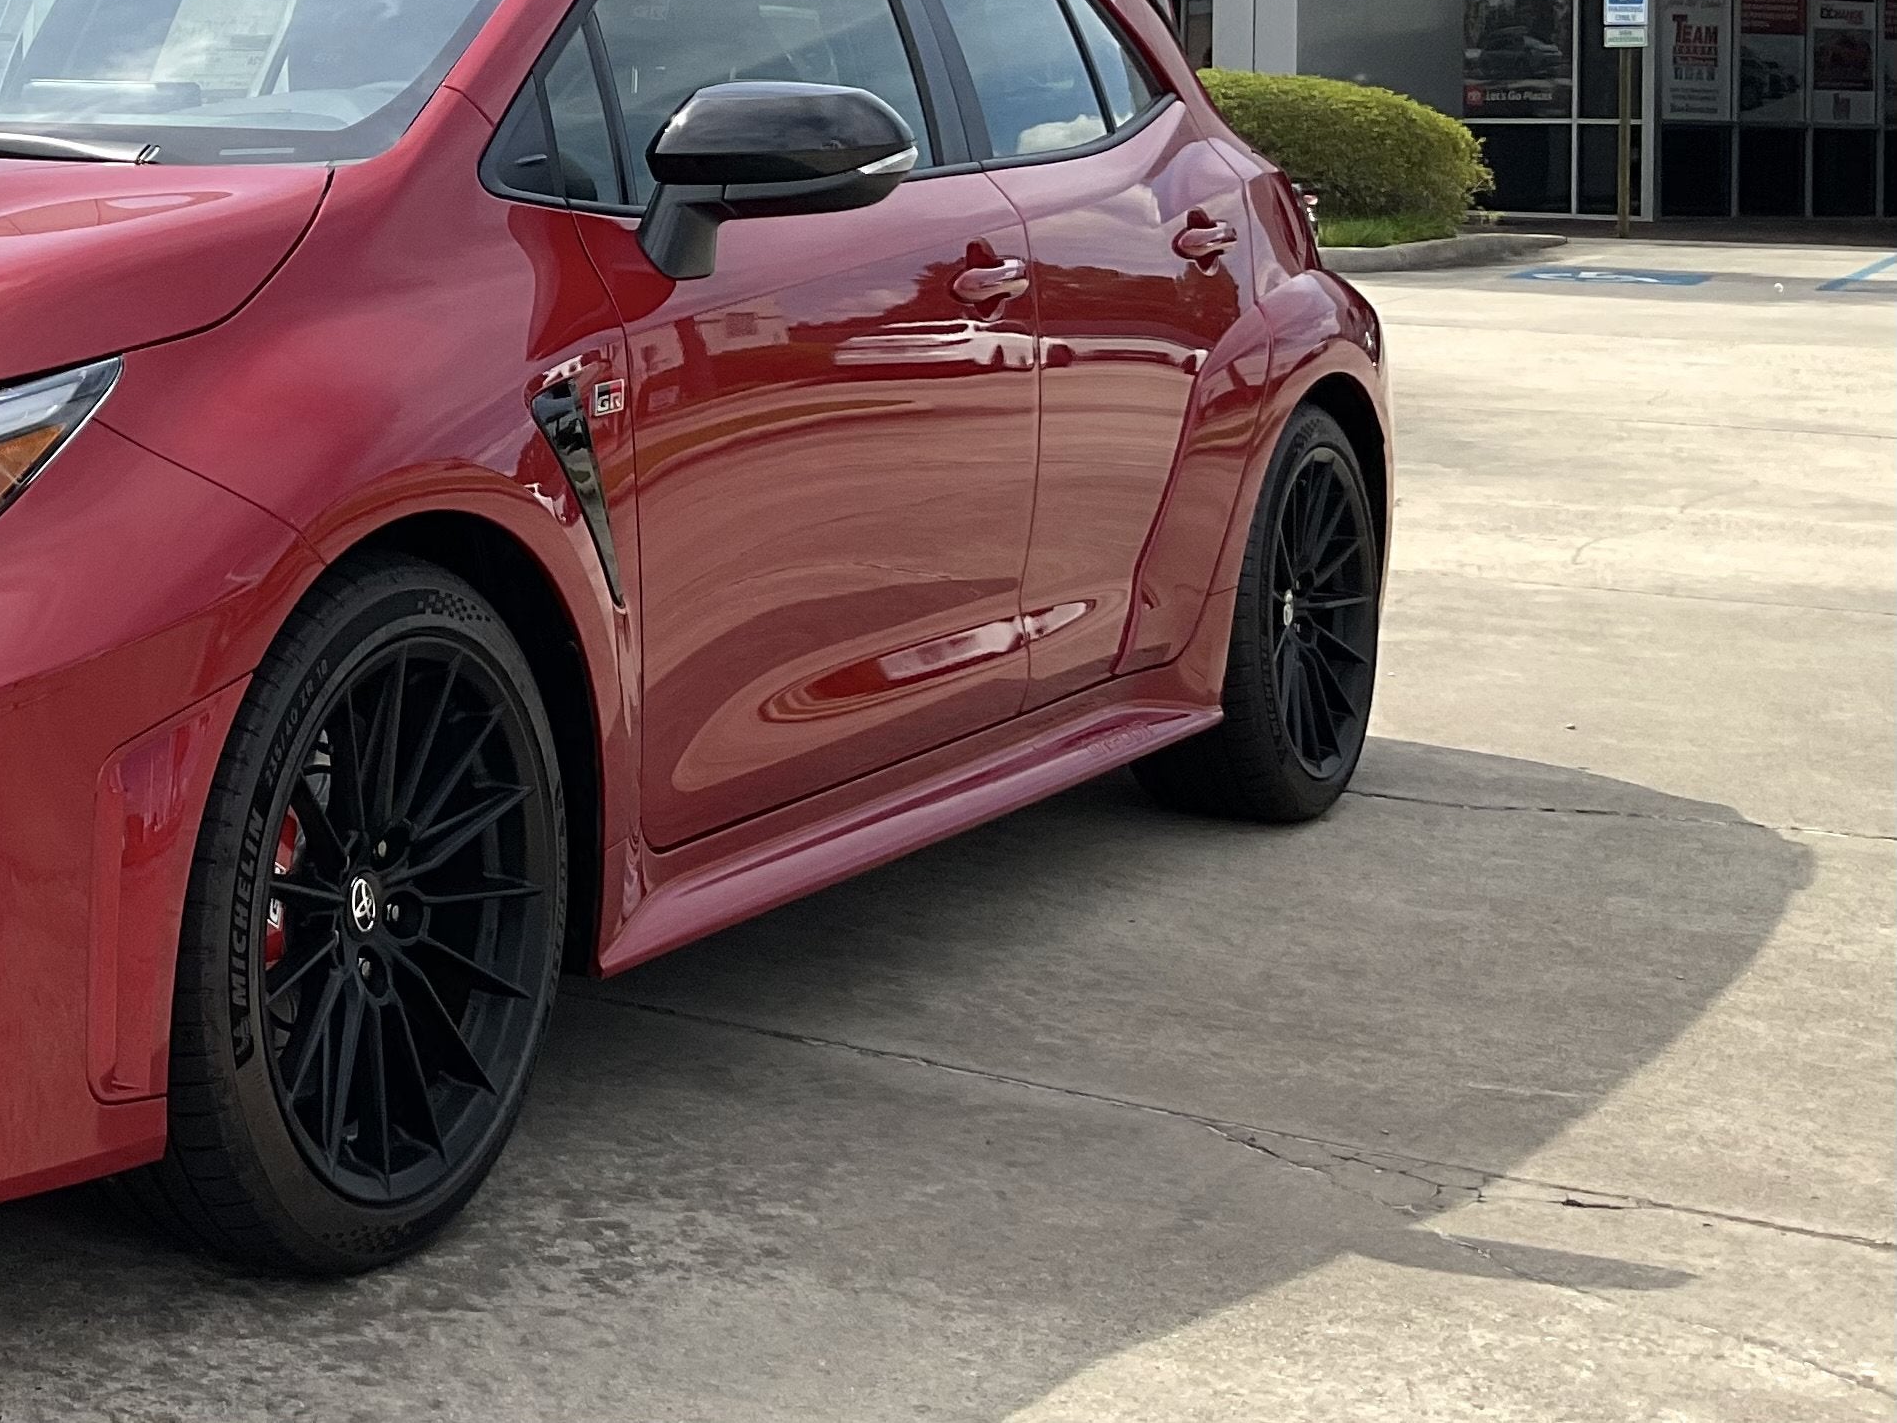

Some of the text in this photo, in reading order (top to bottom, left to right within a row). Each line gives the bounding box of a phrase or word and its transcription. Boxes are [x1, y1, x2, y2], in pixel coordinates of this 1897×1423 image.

[1672, 14, 1719, 44] TEAM
[597, 391, 622, 413] GR
[231, 808, 264, 1007] MICHELIN
